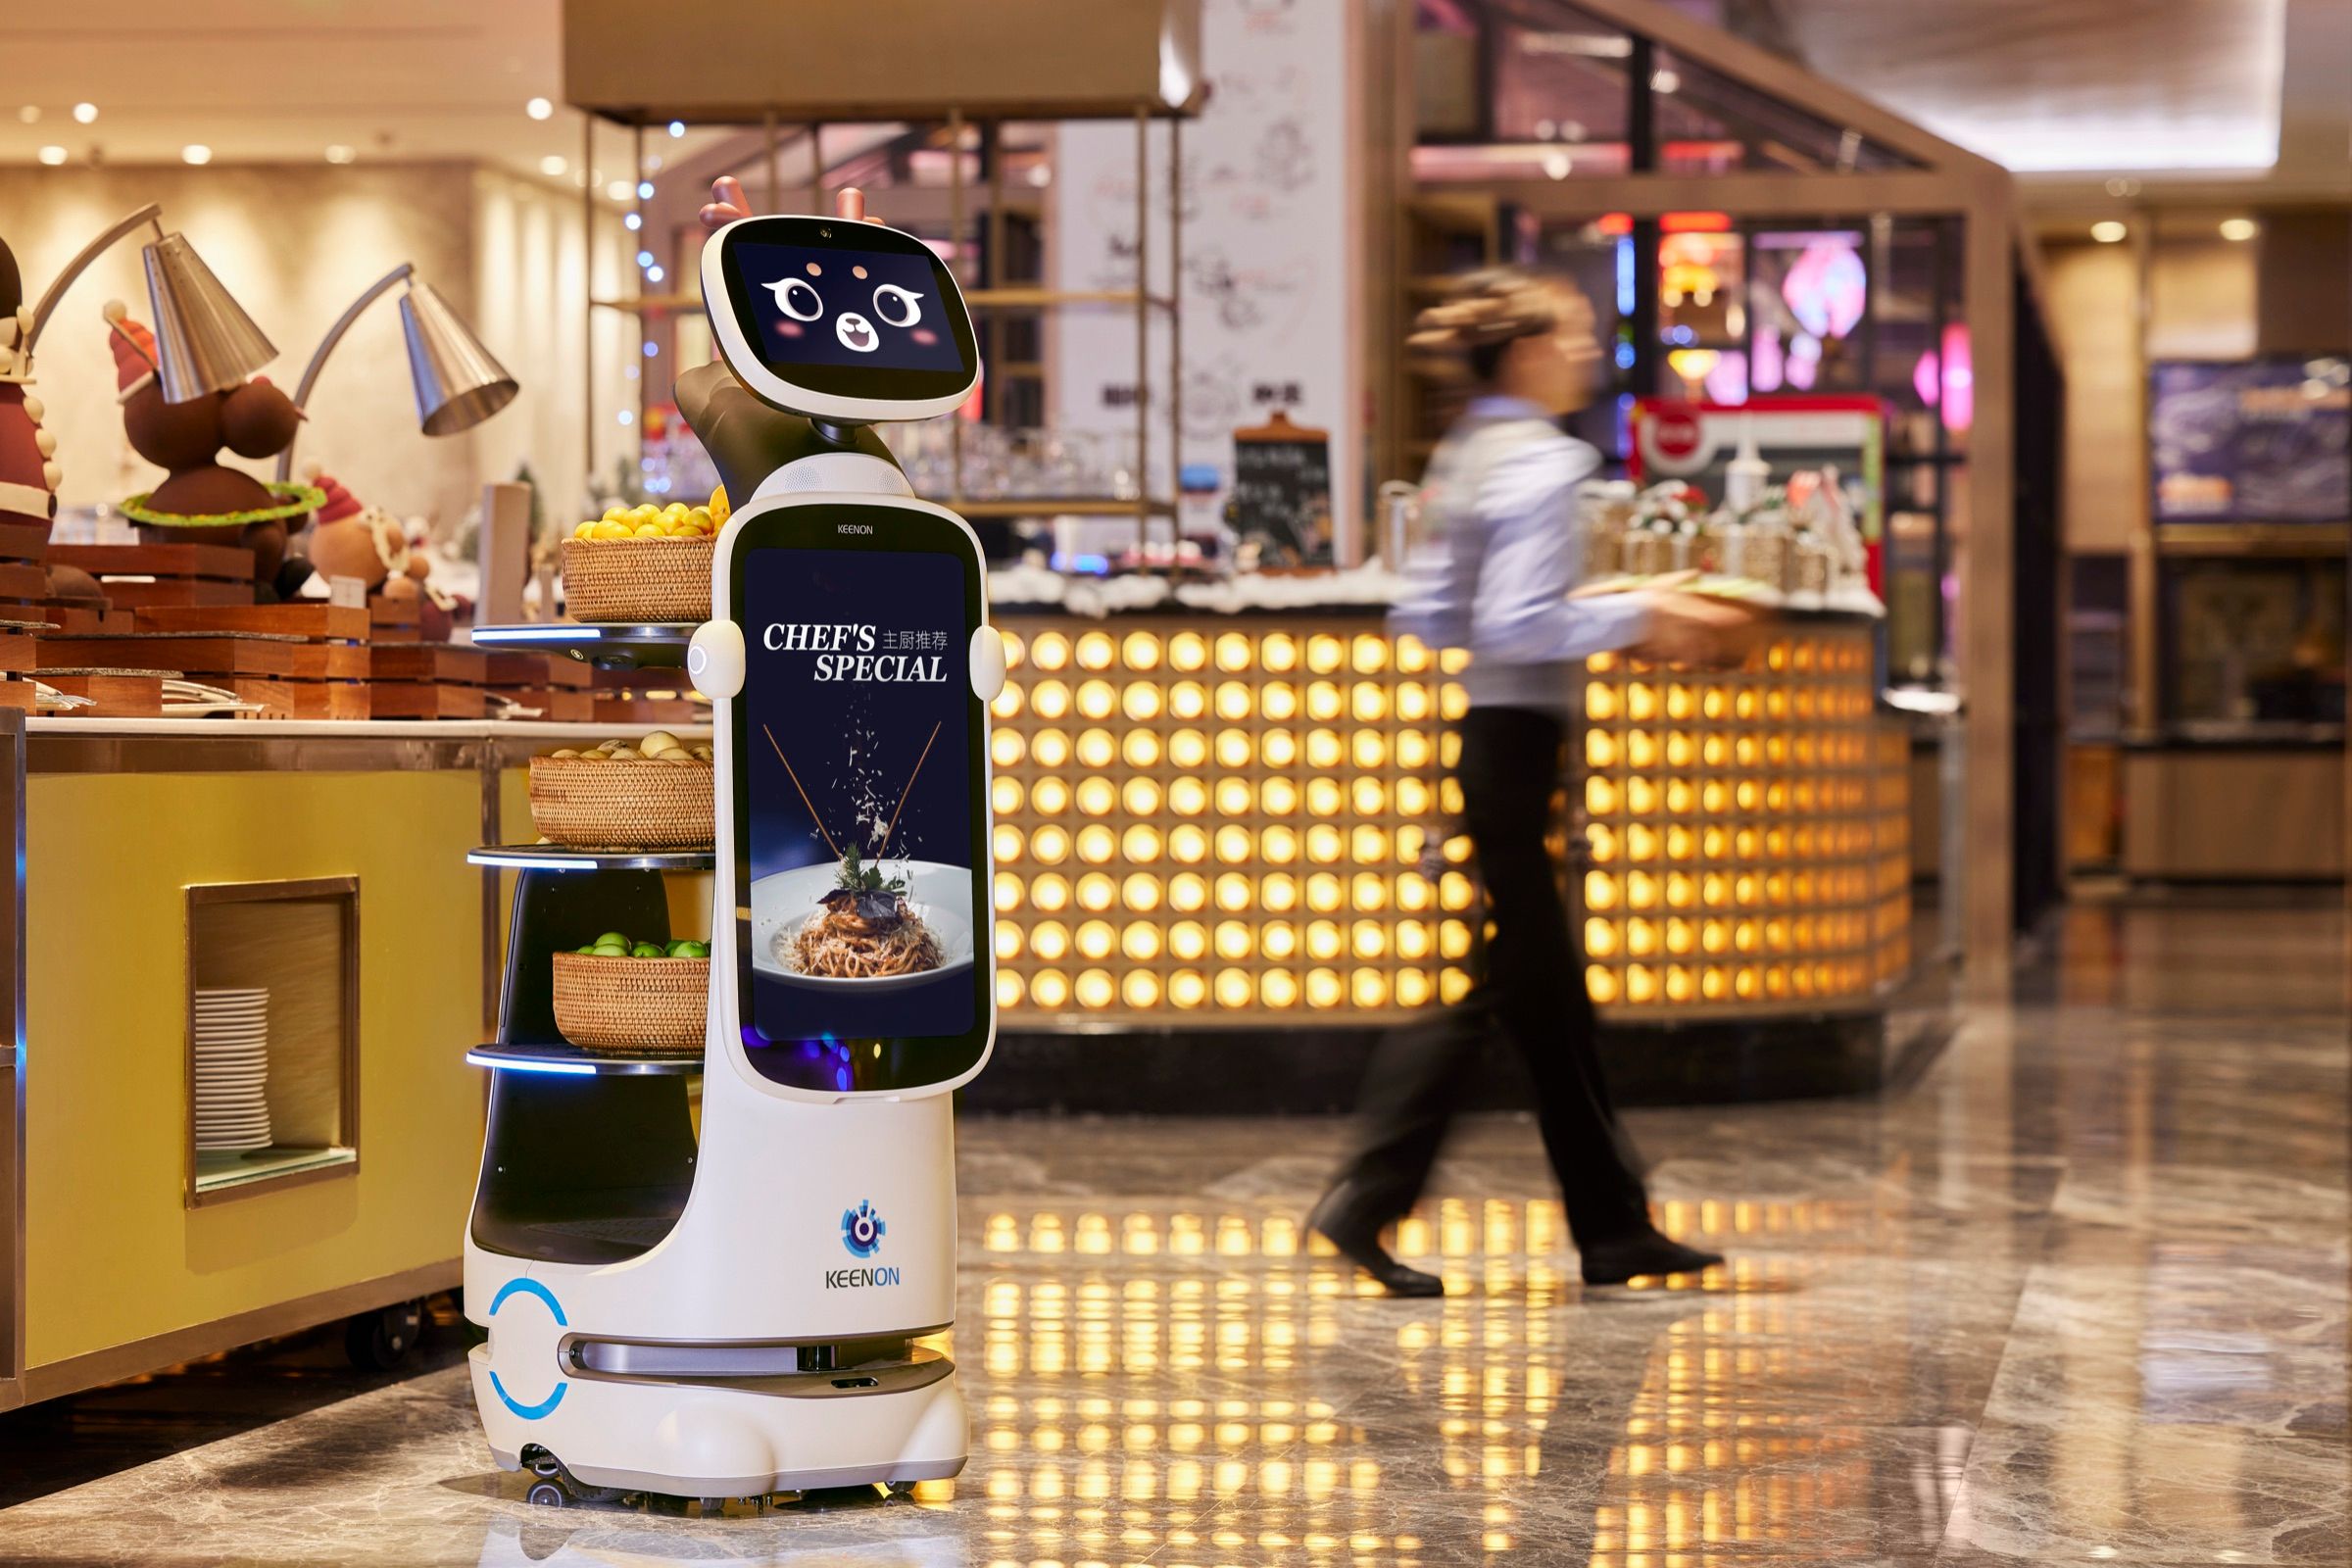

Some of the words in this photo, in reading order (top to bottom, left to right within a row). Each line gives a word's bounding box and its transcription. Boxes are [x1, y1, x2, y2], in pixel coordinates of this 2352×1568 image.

[837, 524, 873, 535] KEENON
[763, 623, 875, 652] CHEF'S
[883, 630, 947, 651] 主厨推荐
[814, 655, 947, 682] SPECIAL
[826, 1267, 900, 1289] KEENON
